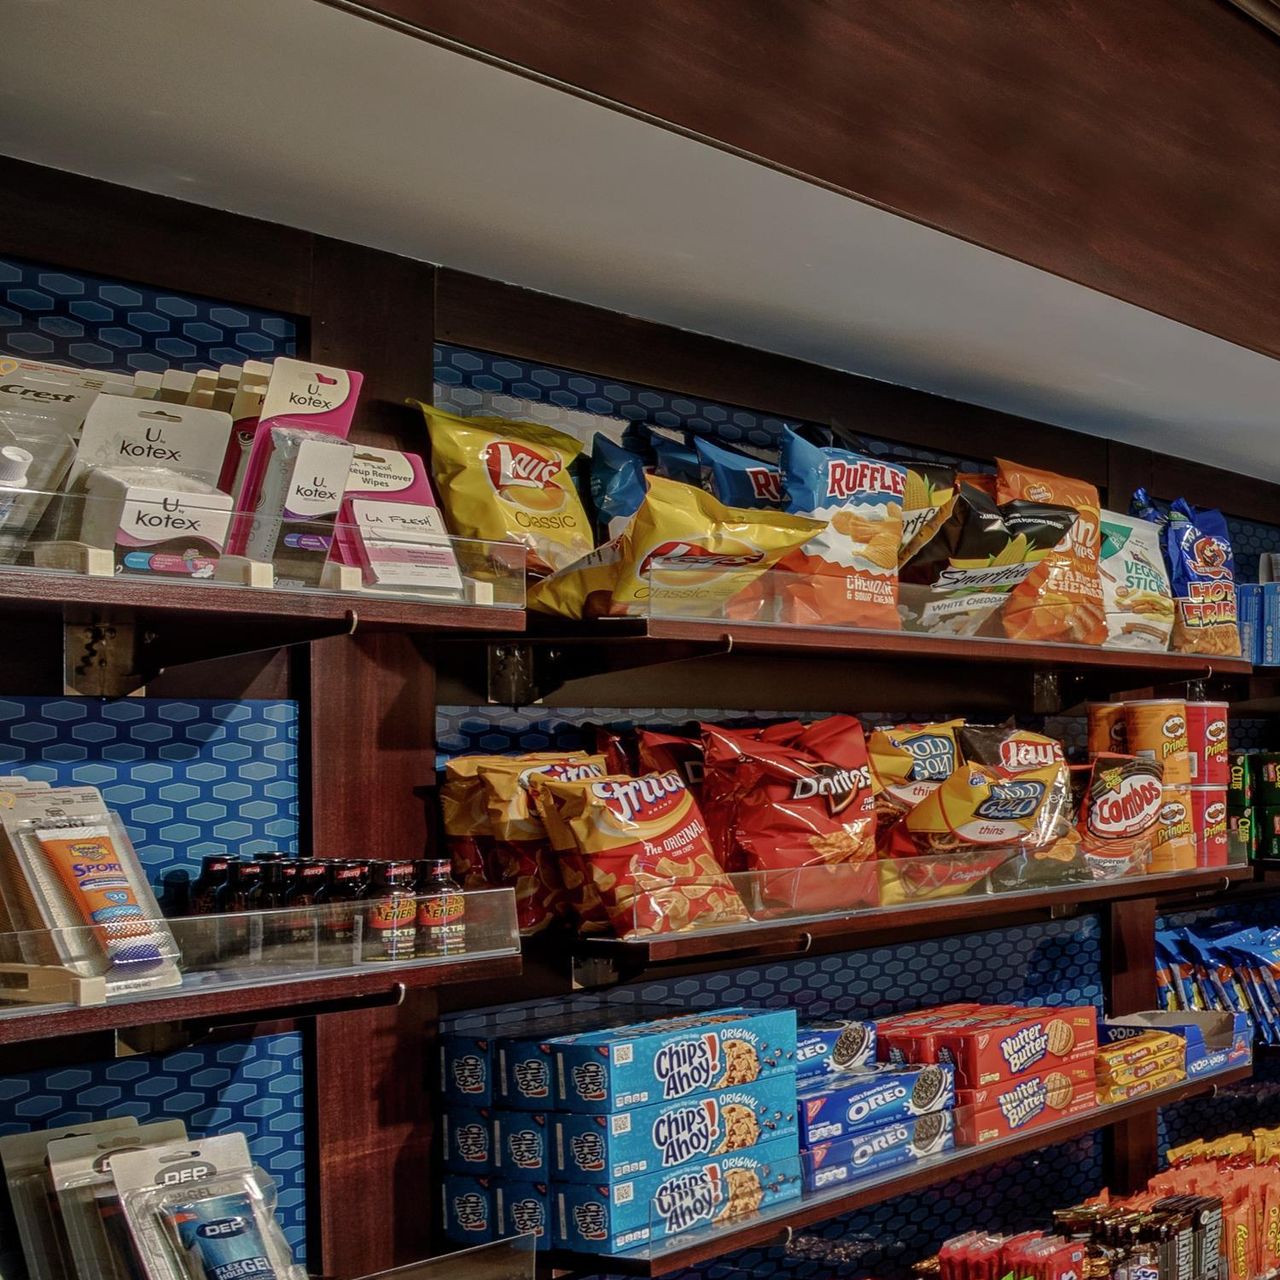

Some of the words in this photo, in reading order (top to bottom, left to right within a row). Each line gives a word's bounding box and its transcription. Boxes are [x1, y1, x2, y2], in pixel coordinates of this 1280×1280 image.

[0, 384, 79, 403] Crest
[308, 384, 320, 395] U
[289, 393, 332, 410] kotex
[146, 427, 162, 442] U
[120, 441, 181, 462] kotex
[313, 477, 324, 487] U
[362, 476, 389, 488] Wipes
[372, 470, 412, 483] Remover
[296, 485, 337, 500] kotex
[163, 498, 180, 513] U
[136, 510, 200, 531] kotex
[389, 514, 432, 527] FRESH
[515, 511, 577, 529] Classic
[634, 586, 710, 599] Classic
[847, 591, 851, 600] &
[854, 592, 872, 602] SOUR
[1189, 582, 1235, 602] HOT
[932, 599, 964, 614] WHITE
[793, 766, 872, 799] Doritos
[592, 773, 686, 822] Fritos
[1097, 782, 1161, 826] Combos
[663, 819, 705, 852] ORIGINAL
[978, 825, 1006, 836] thins
[1158, 823, 1191, 845] Pringles
[952, 866, 991, 881] Original
[111, 891, 127, 901] 30
[720, 1029, 760, 1046] ORIGINAL
[1001, 1024, 1042, 1059] Nutter
[656, 1041, 707, 1079] Chips
[1008, 1034, 1048, 1073] Butter
[583, 1063, 601, 1093] Chips
[719, 1094, 758, 1109] ORIGINAL
[848, 1087, 906, 1122] OREO
[1007, 1086, 1047, 1129] Butter
[655, 1106, 706, 1147] Chips
[582, 1132, 598, 1163] Chips
[852, 1129, 908, 1166] OREO
[722, 1158, 761, 1169] ORIGINA
[164, 1166, 209, 1185] DEP
[656, 1172, 709, 1213] Chips
[584, 1202, 601, 1233] Chips
[205, 1221, 244, 1237] DEP
[1236, 1224, 1250, 1279] Reese's
[215, 1263, 242, 1275] FLEX
